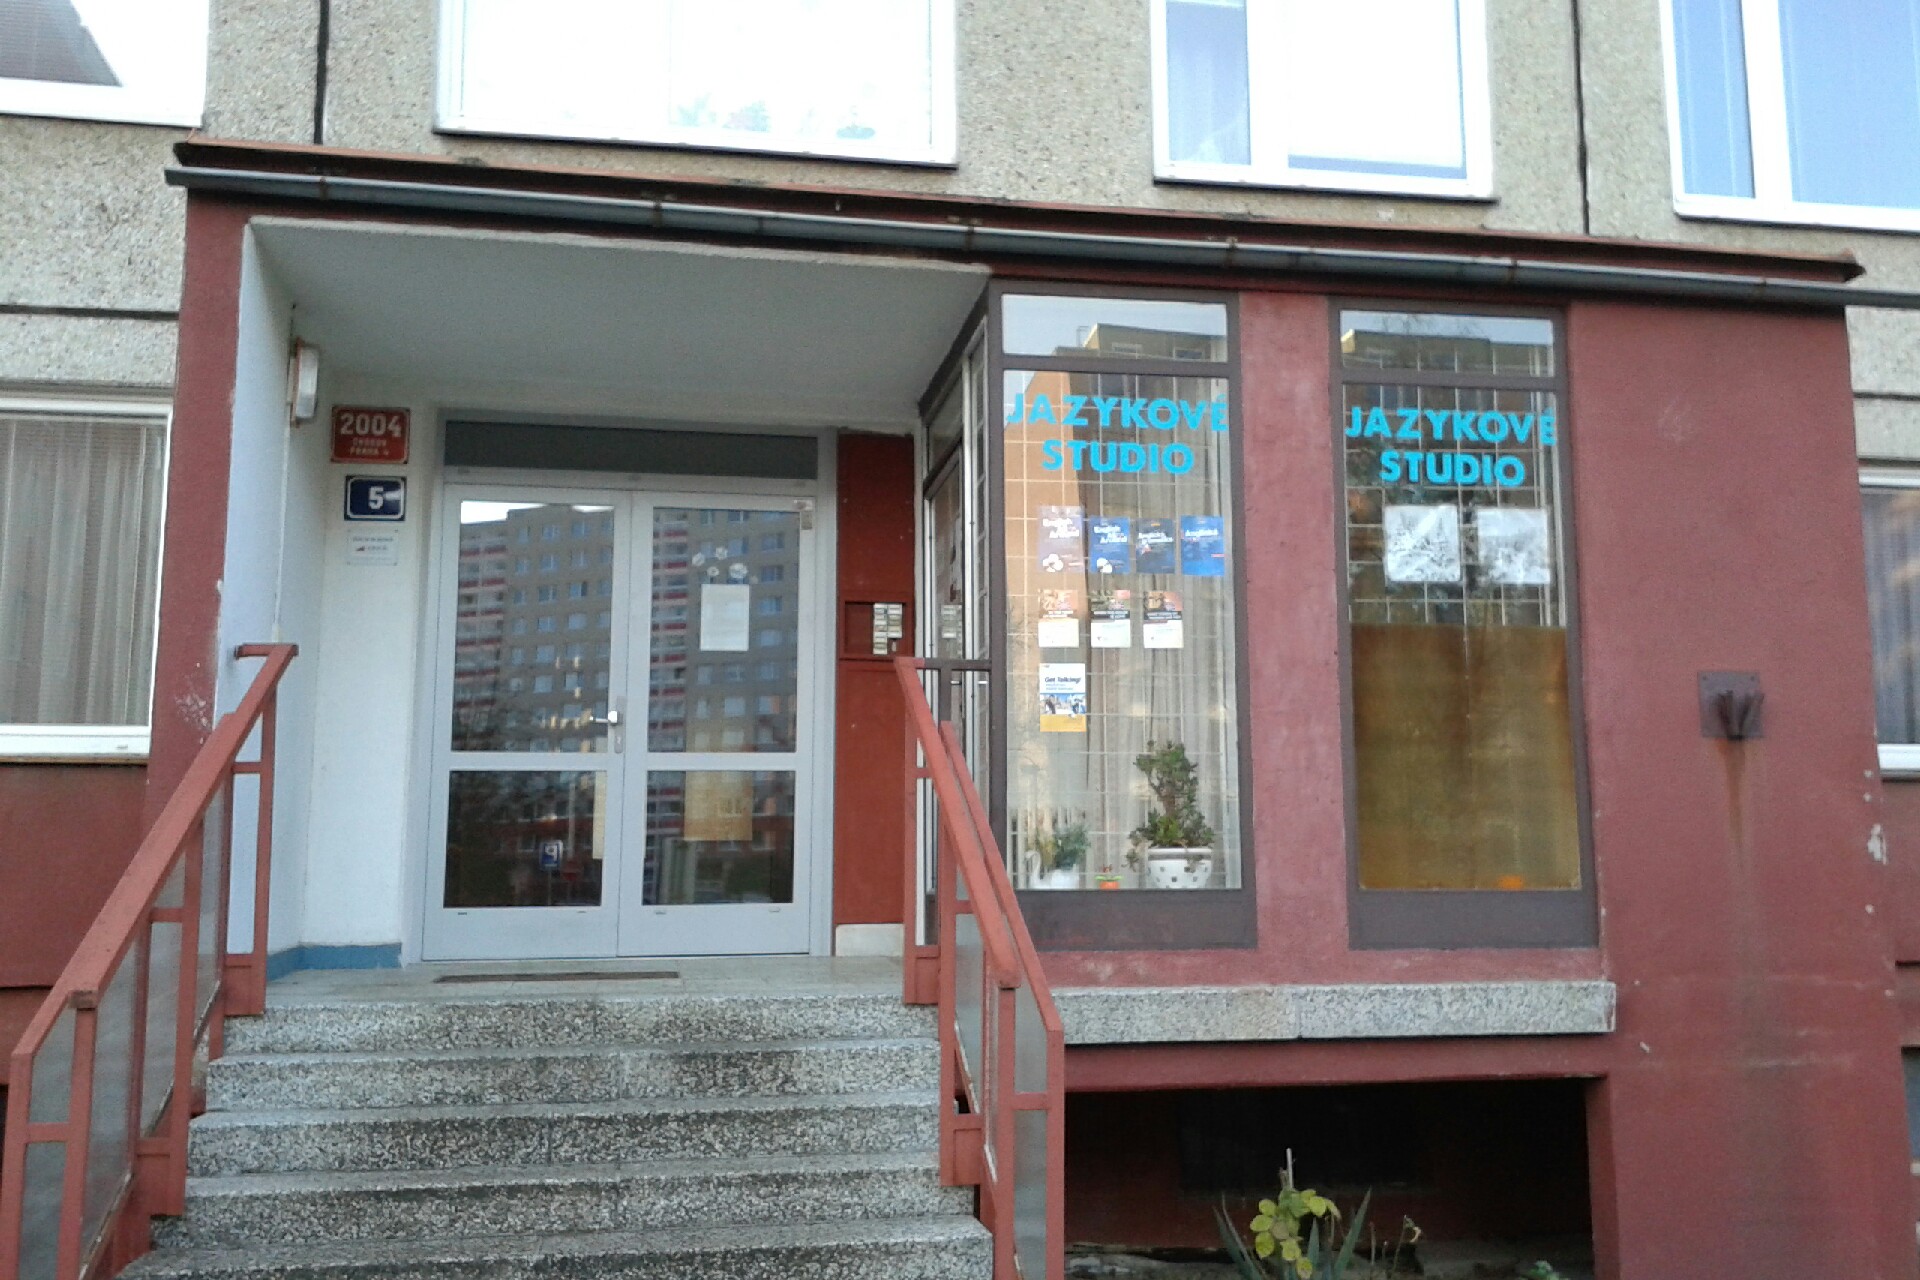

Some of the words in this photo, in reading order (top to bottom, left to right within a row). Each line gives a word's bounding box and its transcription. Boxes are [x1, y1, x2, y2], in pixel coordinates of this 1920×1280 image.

[340, 413, 402, 438] 2004
[1006, 393, 1229, 432] JAZYKOVÉ
[1345, 406, 1557, 446] JAZYKOVÉ
[1041, 439, 1195, 475] STUDIO
[1379, 449, 1526, 487] STUDIO
[368, 486, 384, 510] 5
